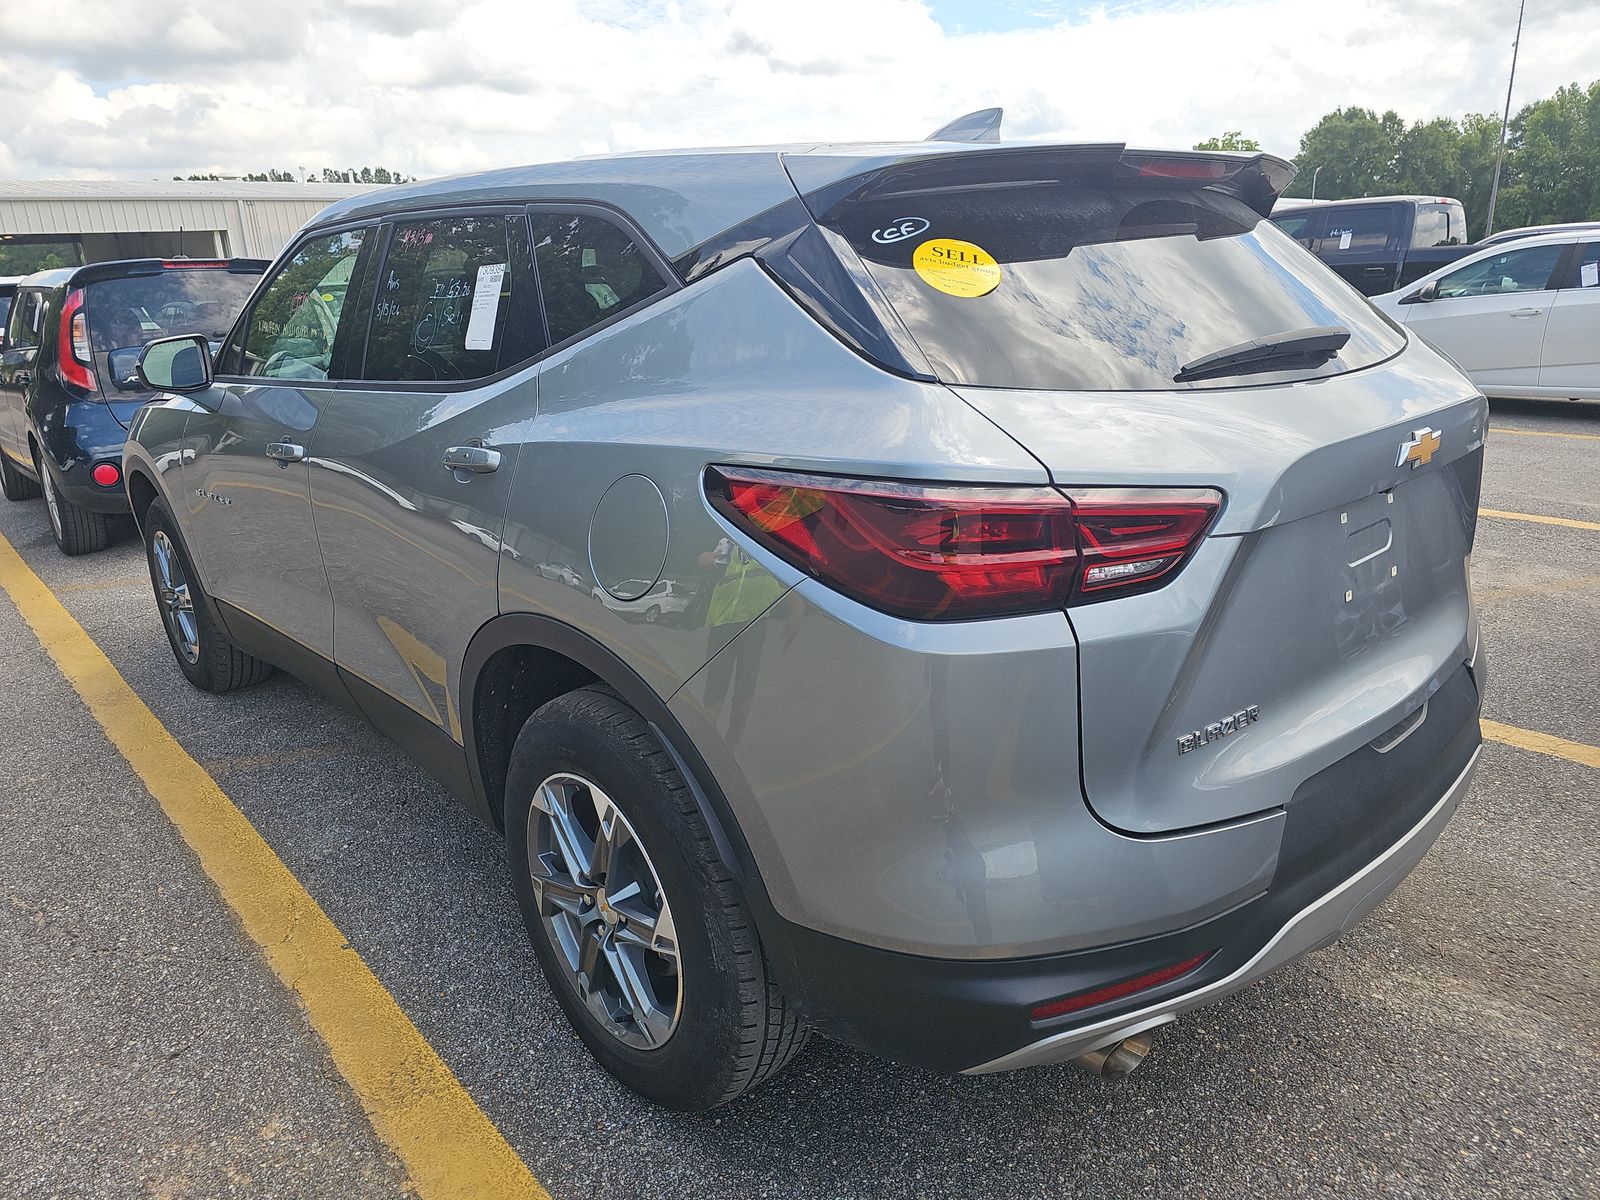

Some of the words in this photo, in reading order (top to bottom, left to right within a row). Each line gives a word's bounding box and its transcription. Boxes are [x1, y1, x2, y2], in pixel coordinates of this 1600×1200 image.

[919, 256, 937, 264] avis
[939, 259, 969, 269] budget
[971, 266, 997, 276] group
[931, 246, 985, 266] SELL
[1176, 703, 1261, 756] BLAZER
